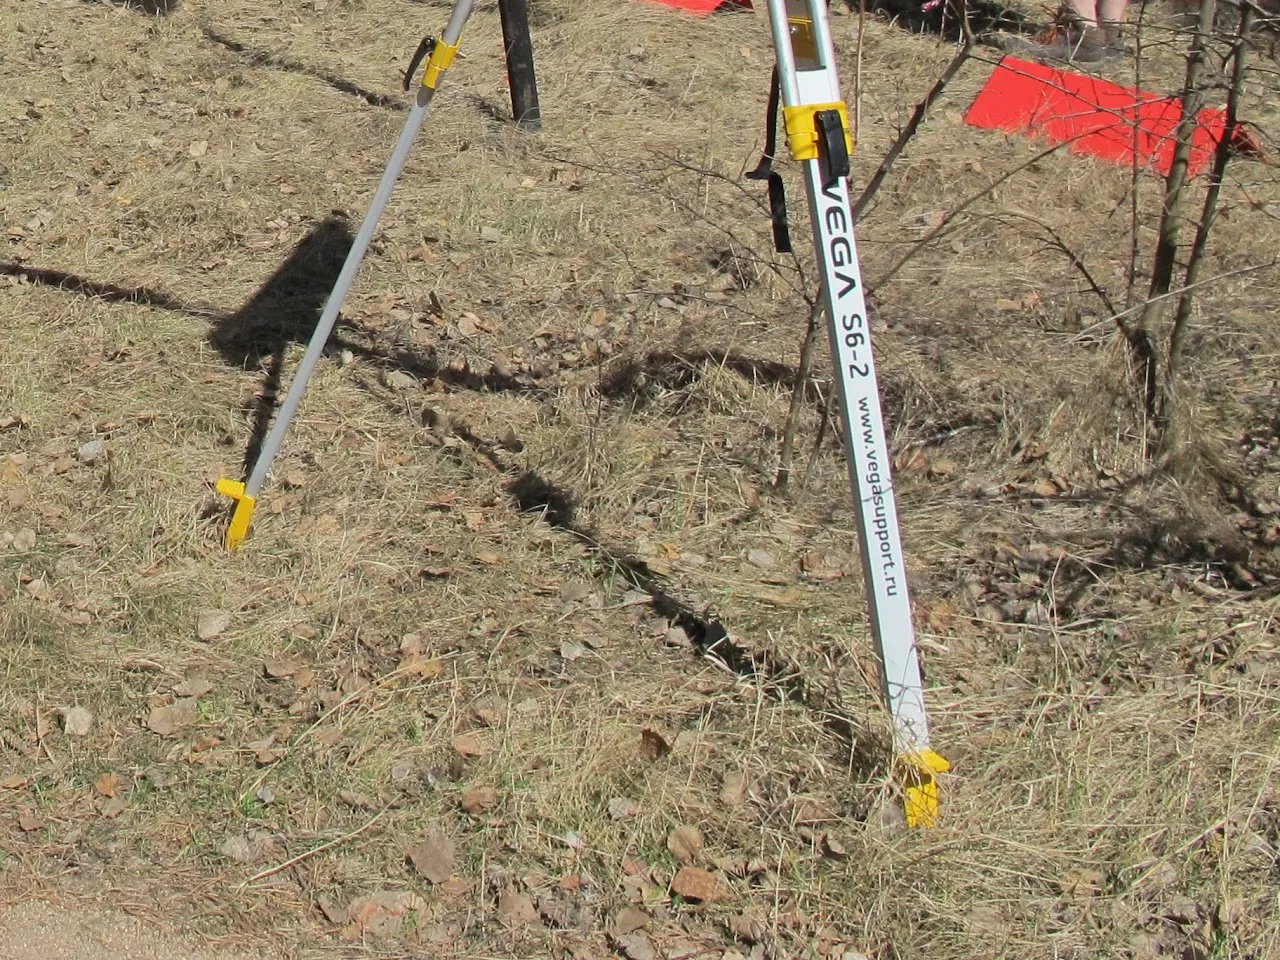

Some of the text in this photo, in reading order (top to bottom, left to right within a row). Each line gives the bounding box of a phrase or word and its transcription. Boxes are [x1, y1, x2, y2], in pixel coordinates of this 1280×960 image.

[822, 176, 897, 597] VEGA S6-2 www.vegasupport.ru
